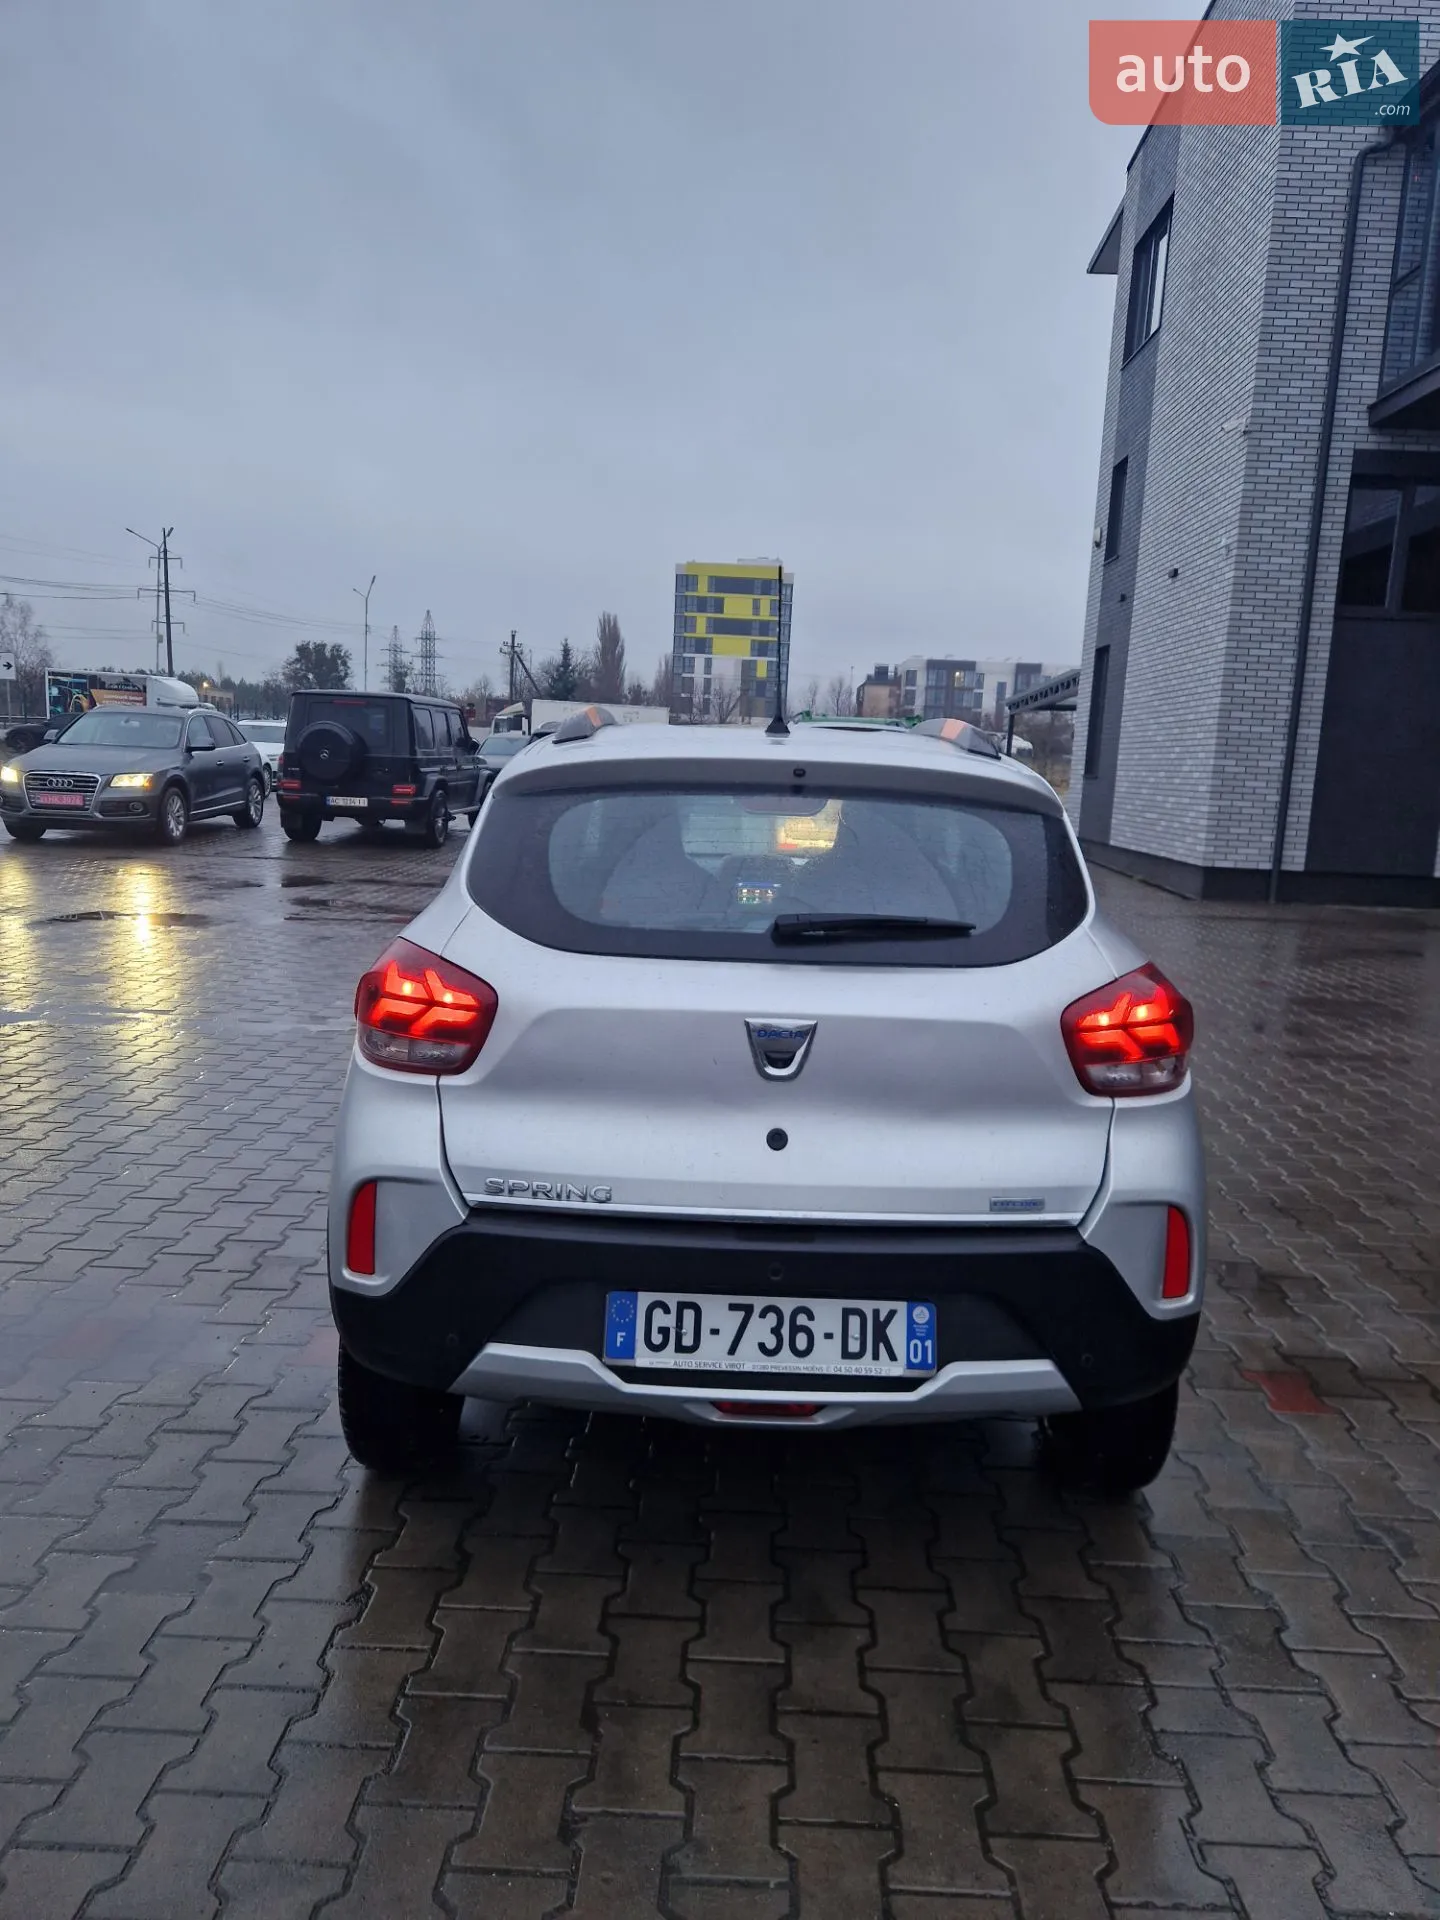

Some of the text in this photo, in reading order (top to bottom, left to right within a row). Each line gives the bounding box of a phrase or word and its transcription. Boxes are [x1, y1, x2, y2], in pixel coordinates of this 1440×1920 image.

[757, 1029, 804, 1039] DACIA
[484, 1177, 613, 1203] SPRING
[616, 1331, 626, 1347] F
[643, 1300, 899, 1362] GD-736-DK
[909, 1338, 933, 1365] 01
[672, 1360, 693, 1368] AUTO
[694, 1361, 722, 1369] SERVICE
[833, 1365, 842, 1373] 04
